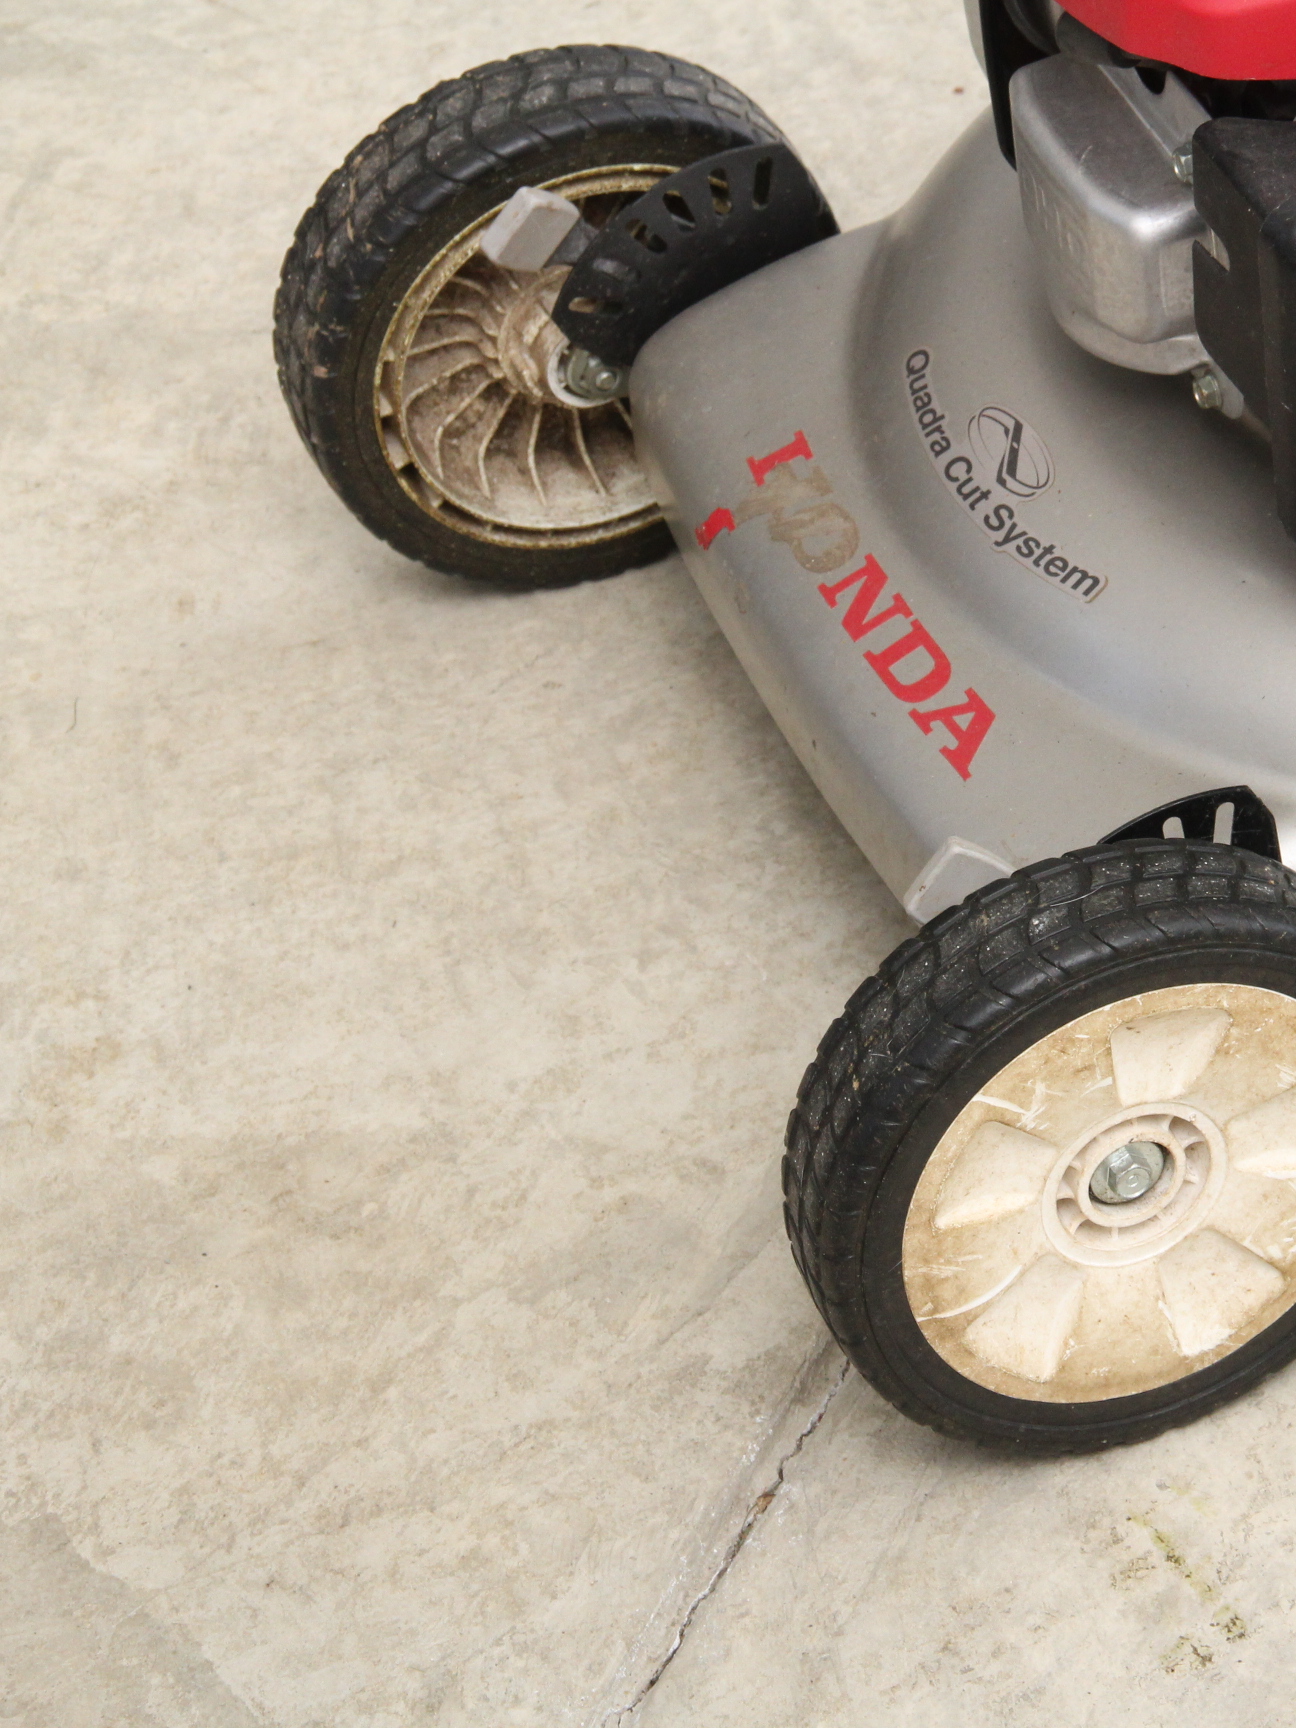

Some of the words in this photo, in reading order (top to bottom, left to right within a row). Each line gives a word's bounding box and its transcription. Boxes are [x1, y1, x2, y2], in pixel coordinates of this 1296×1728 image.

[905, 349, 952, 458] Quadra
[943, 456, 992, 511] Cut
[983, 504, 1101, 598] System
